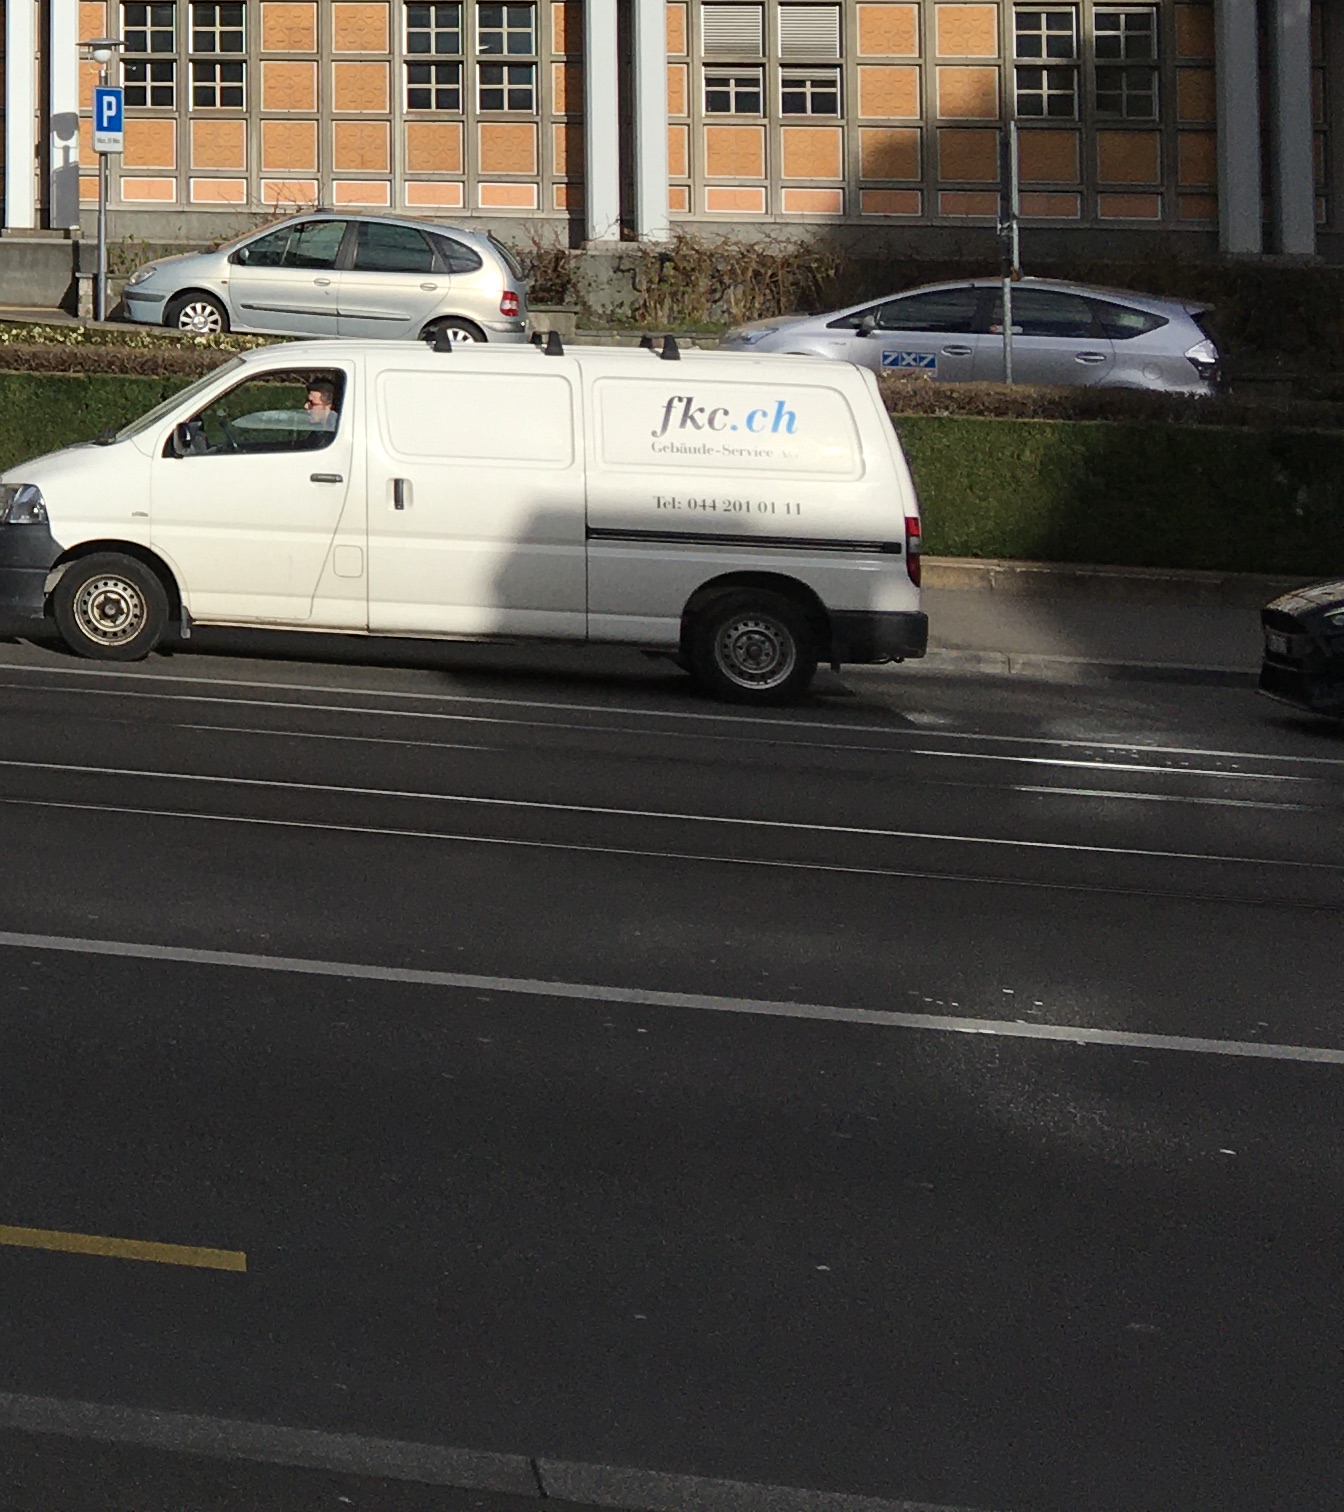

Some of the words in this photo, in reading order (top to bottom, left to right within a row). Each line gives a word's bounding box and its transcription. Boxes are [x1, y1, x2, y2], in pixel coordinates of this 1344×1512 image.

[102, 95, 117, 128] P
[650, 395, 799, 439] fkc.ch
[651, 441, 774, 458] Gebäude-Service
[653, 496, 682, 510] Tel:
[687, 497, 718, 512] 044
[722, 499, 751, 513] 201
[757, 500, 776, 514] 01
[784, 502, 802, 516] 11
